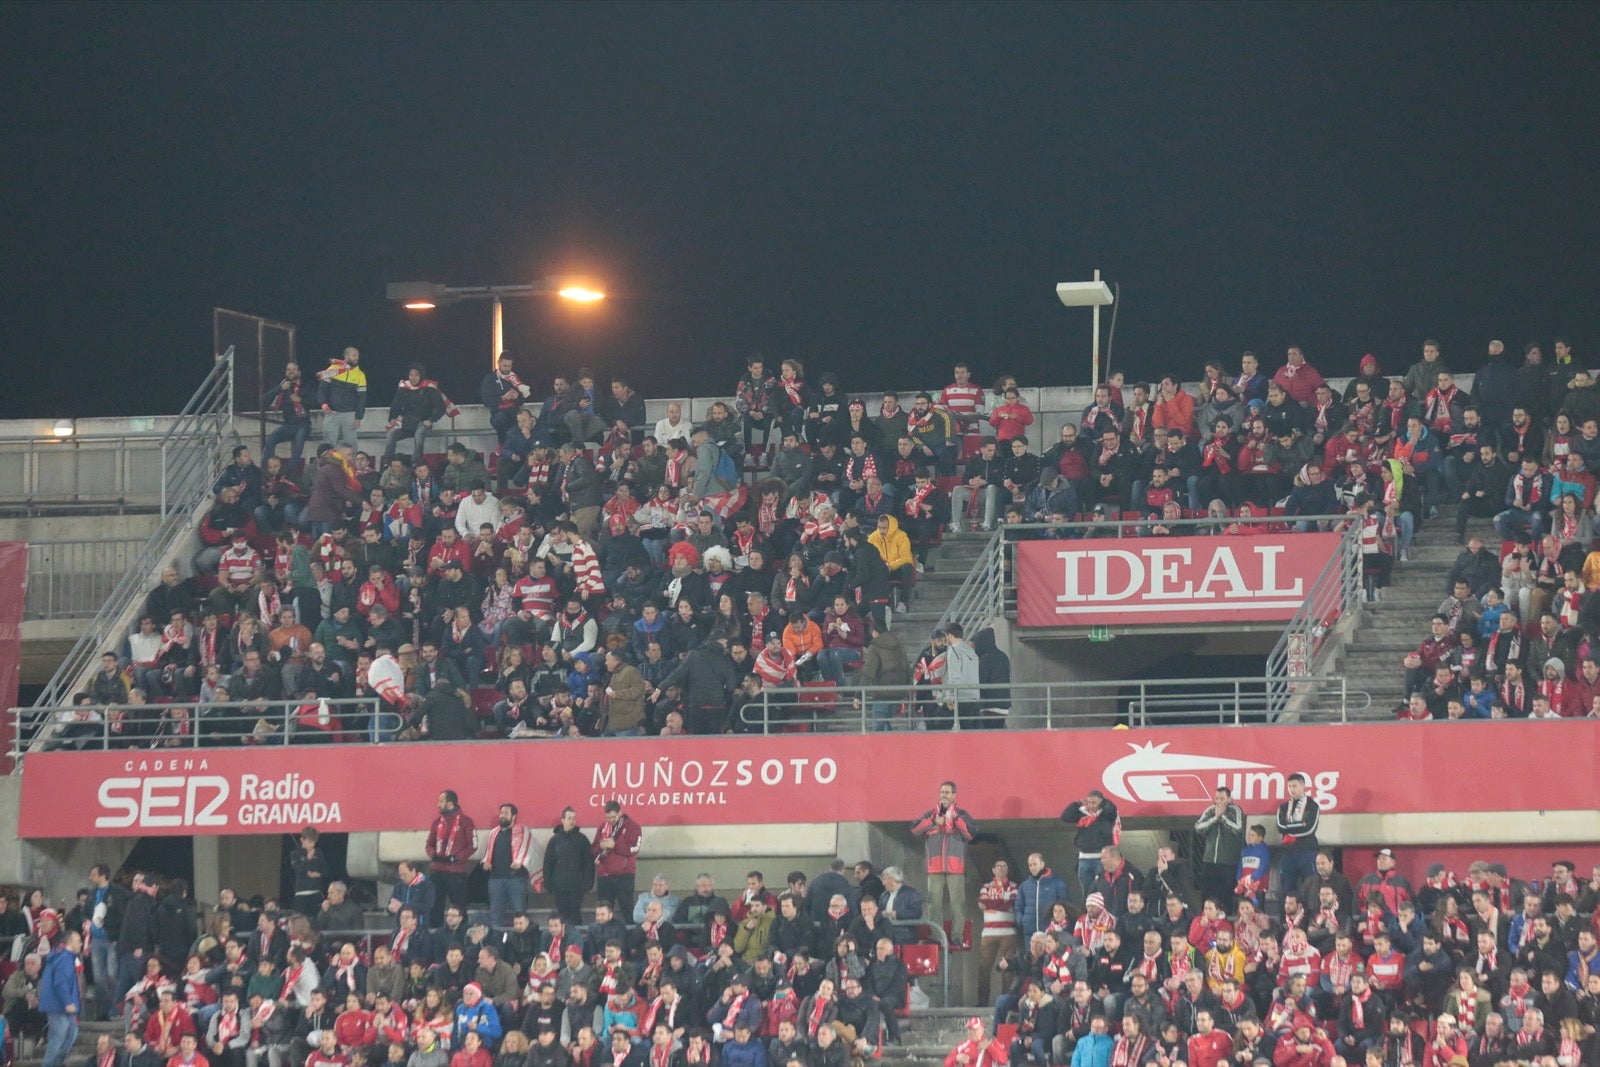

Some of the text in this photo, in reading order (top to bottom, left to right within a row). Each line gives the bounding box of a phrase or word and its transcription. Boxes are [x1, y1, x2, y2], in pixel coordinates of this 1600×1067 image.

[1056, 545, 1303, 602] IDEAL
[125, 759, 208, 772] CADENA
[240, 773, 315, 800] Radio
[95, 775, 229, 828] SER
[238, 802, 342, 825] GRANADA
